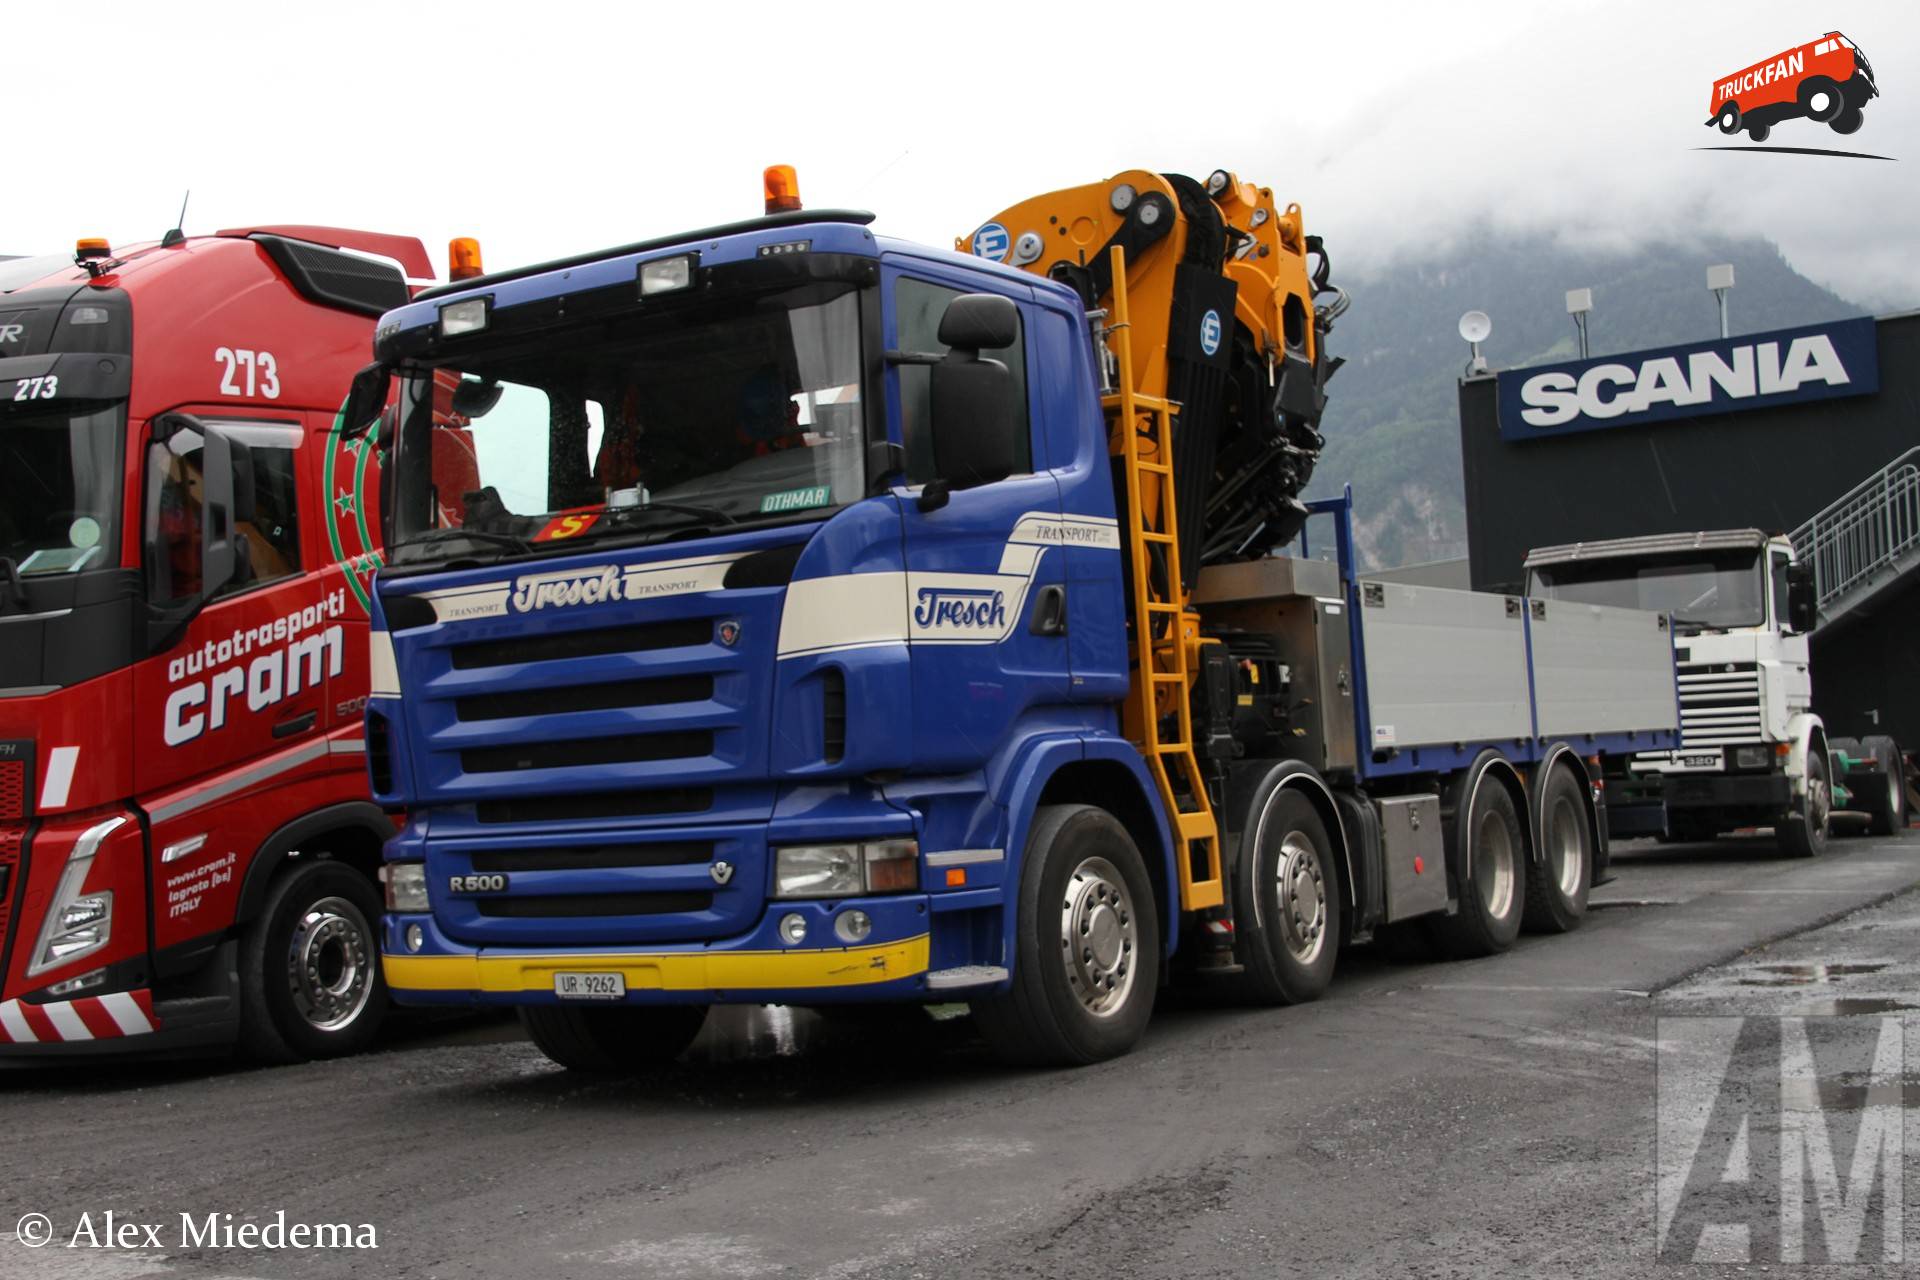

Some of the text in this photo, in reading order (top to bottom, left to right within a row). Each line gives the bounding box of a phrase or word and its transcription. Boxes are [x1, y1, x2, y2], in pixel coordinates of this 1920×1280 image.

[14, 374, 59, 402] 273
[214, 346, 281, 400] 273
[1520, 334, 1851, 428] SCANIA
[763, 486, 827, 512] OTHMAR
[1035, 525, 1099, 543] TRANSPORT
[448, 564, 701, 617] TRANSPORT Tresch TRANSPORT
[914, 585, 1006, 629] Tresch
[168, 587, 346, 683] autotrasporti
[163, 624, 346, 748] cram
[167, 851, 237, 888] www.cram.it
[169, 896, 202, 919] ITALY
